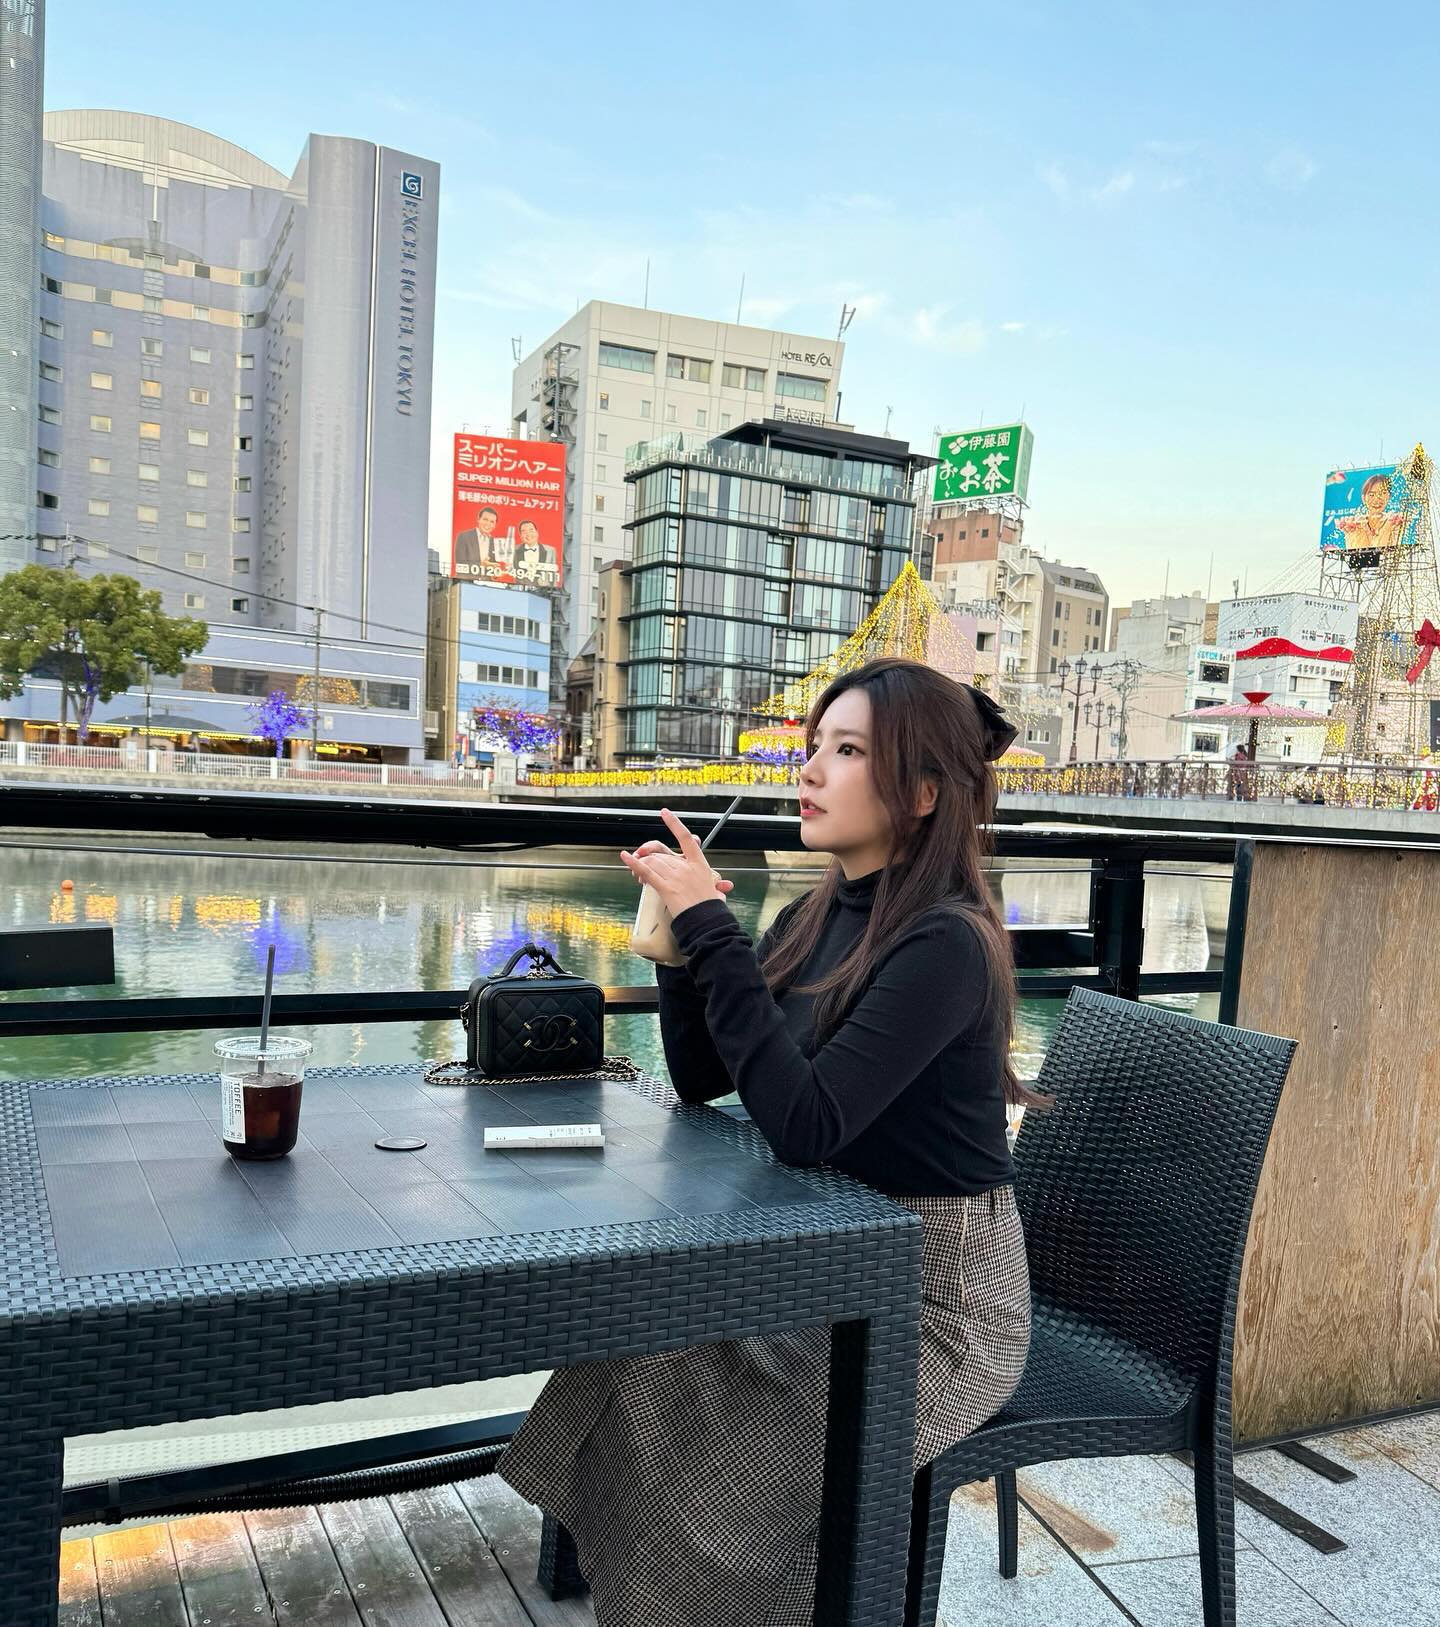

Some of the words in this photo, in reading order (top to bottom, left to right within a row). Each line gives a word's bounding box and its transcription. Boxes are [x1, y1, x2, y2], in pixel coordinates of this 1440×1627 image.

[401, 200, 418, 263] EXCEL
[398, 269, 416, 338] HOTEL
[781, 352, 802, 362] HOTEL
[804, 353, 832, 367] RESOL
[396, 345, 414, 416] TOKYU
[458, 439, 518, 456] スーパー
[969, 431, 1011, 451] 伊藤園
[458, 452, 561, 474] ミリオンヘアー
[959, 452, 1011, 494] お茶
[457, 472, 493, 484] SUPER
[495, 476, 533, 488] MILLION
[535, 481, 560, 491] HAIR
